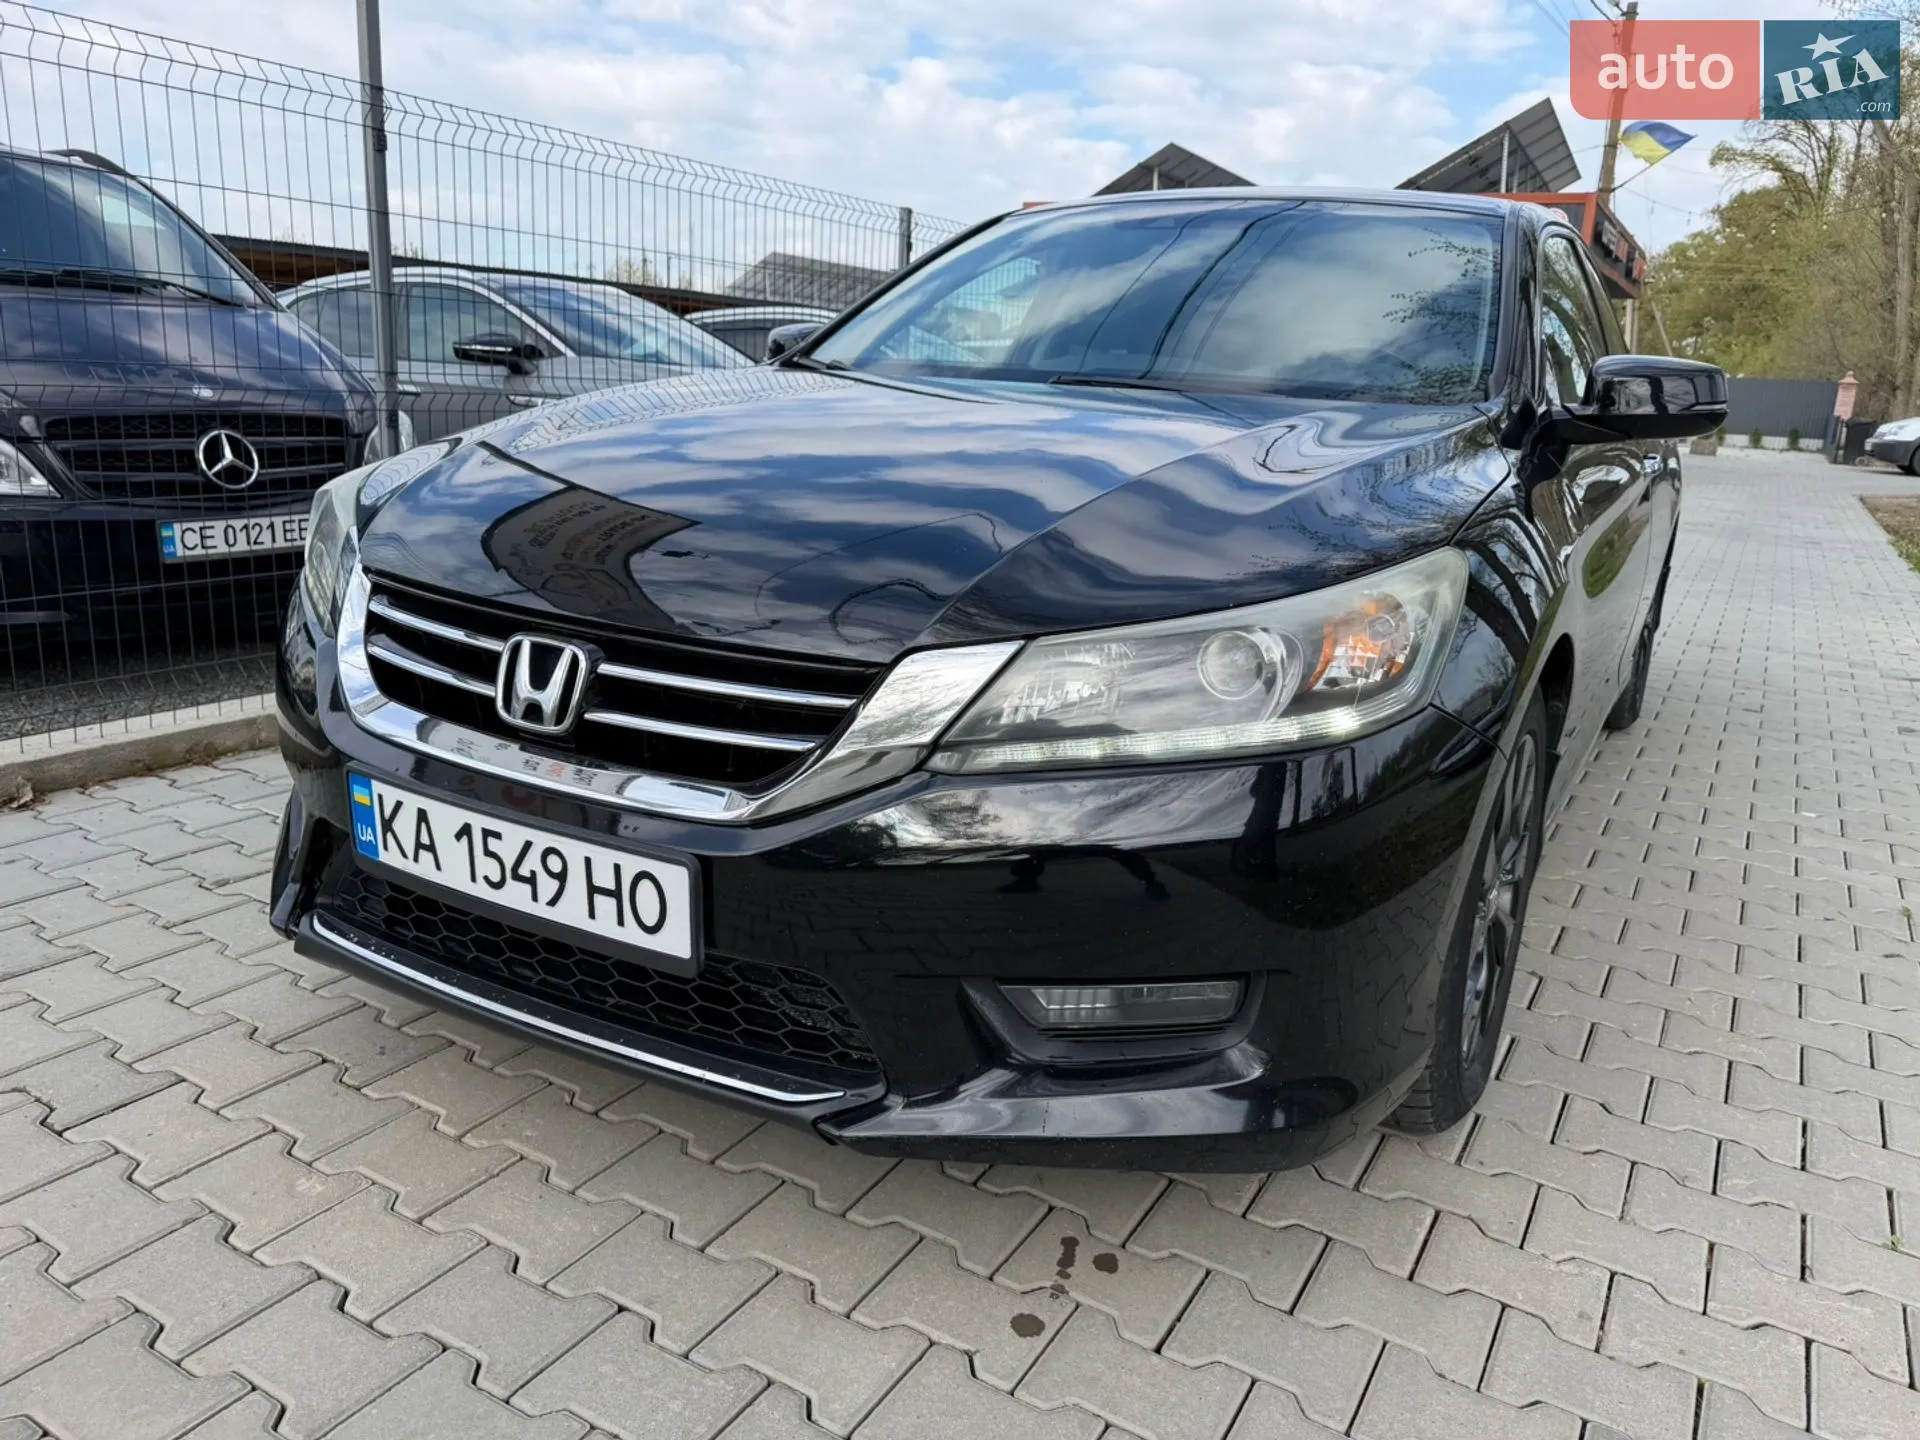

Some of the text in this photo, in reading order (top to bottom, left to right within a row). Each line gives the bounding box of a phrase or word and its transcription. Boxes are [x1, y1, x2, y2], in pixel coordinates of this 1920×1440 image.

[180, 525, 218, 551] CE
[223, 520, 277, 548] 0121
[357, 822, 376, 846] UA
[377, 793, 668, 936] KA 1549 HO
